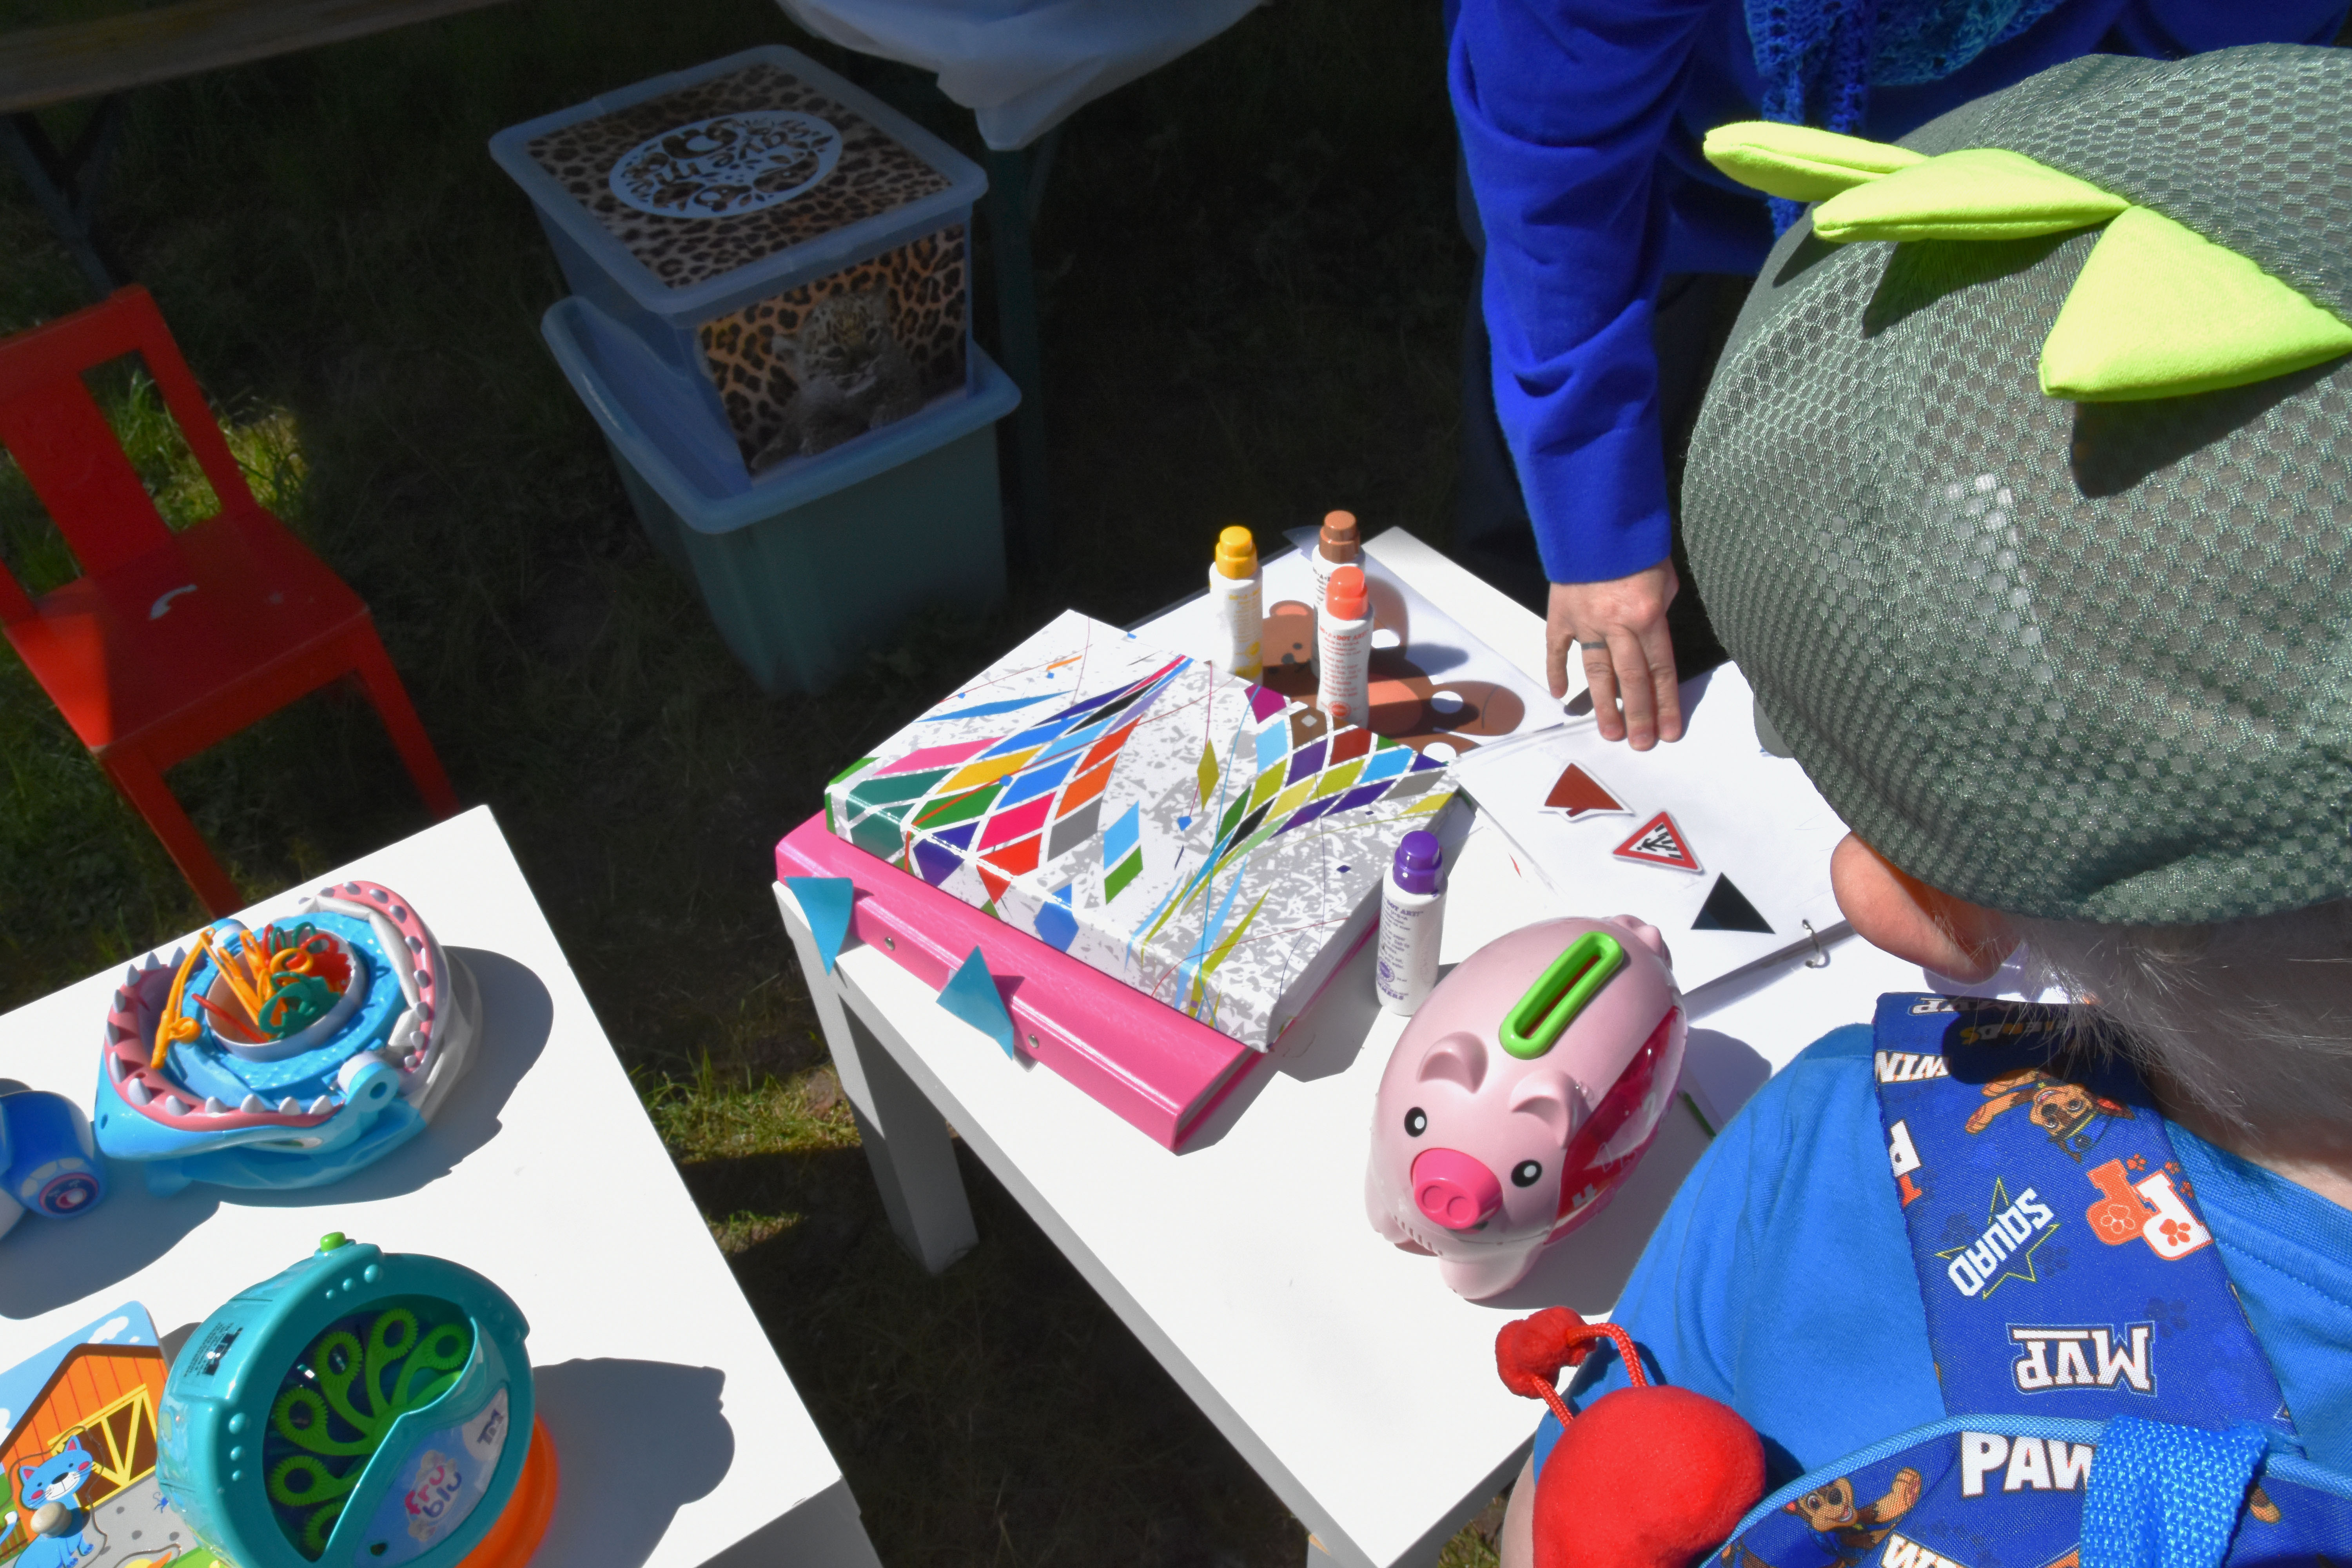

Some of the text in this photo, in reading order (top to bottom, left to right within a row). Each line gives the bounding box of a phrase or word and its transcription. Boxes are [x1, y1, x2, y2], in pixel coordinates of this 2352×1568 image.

[1948, 1188, 2054, 1296] SQUAD
[2012, 1327, 2151, 1391] MVP
[404, 1465, 445, 1515] fru
[422, 1472, 462, 1518] blu
[1961, 1430, 2094, 1497] PAW
